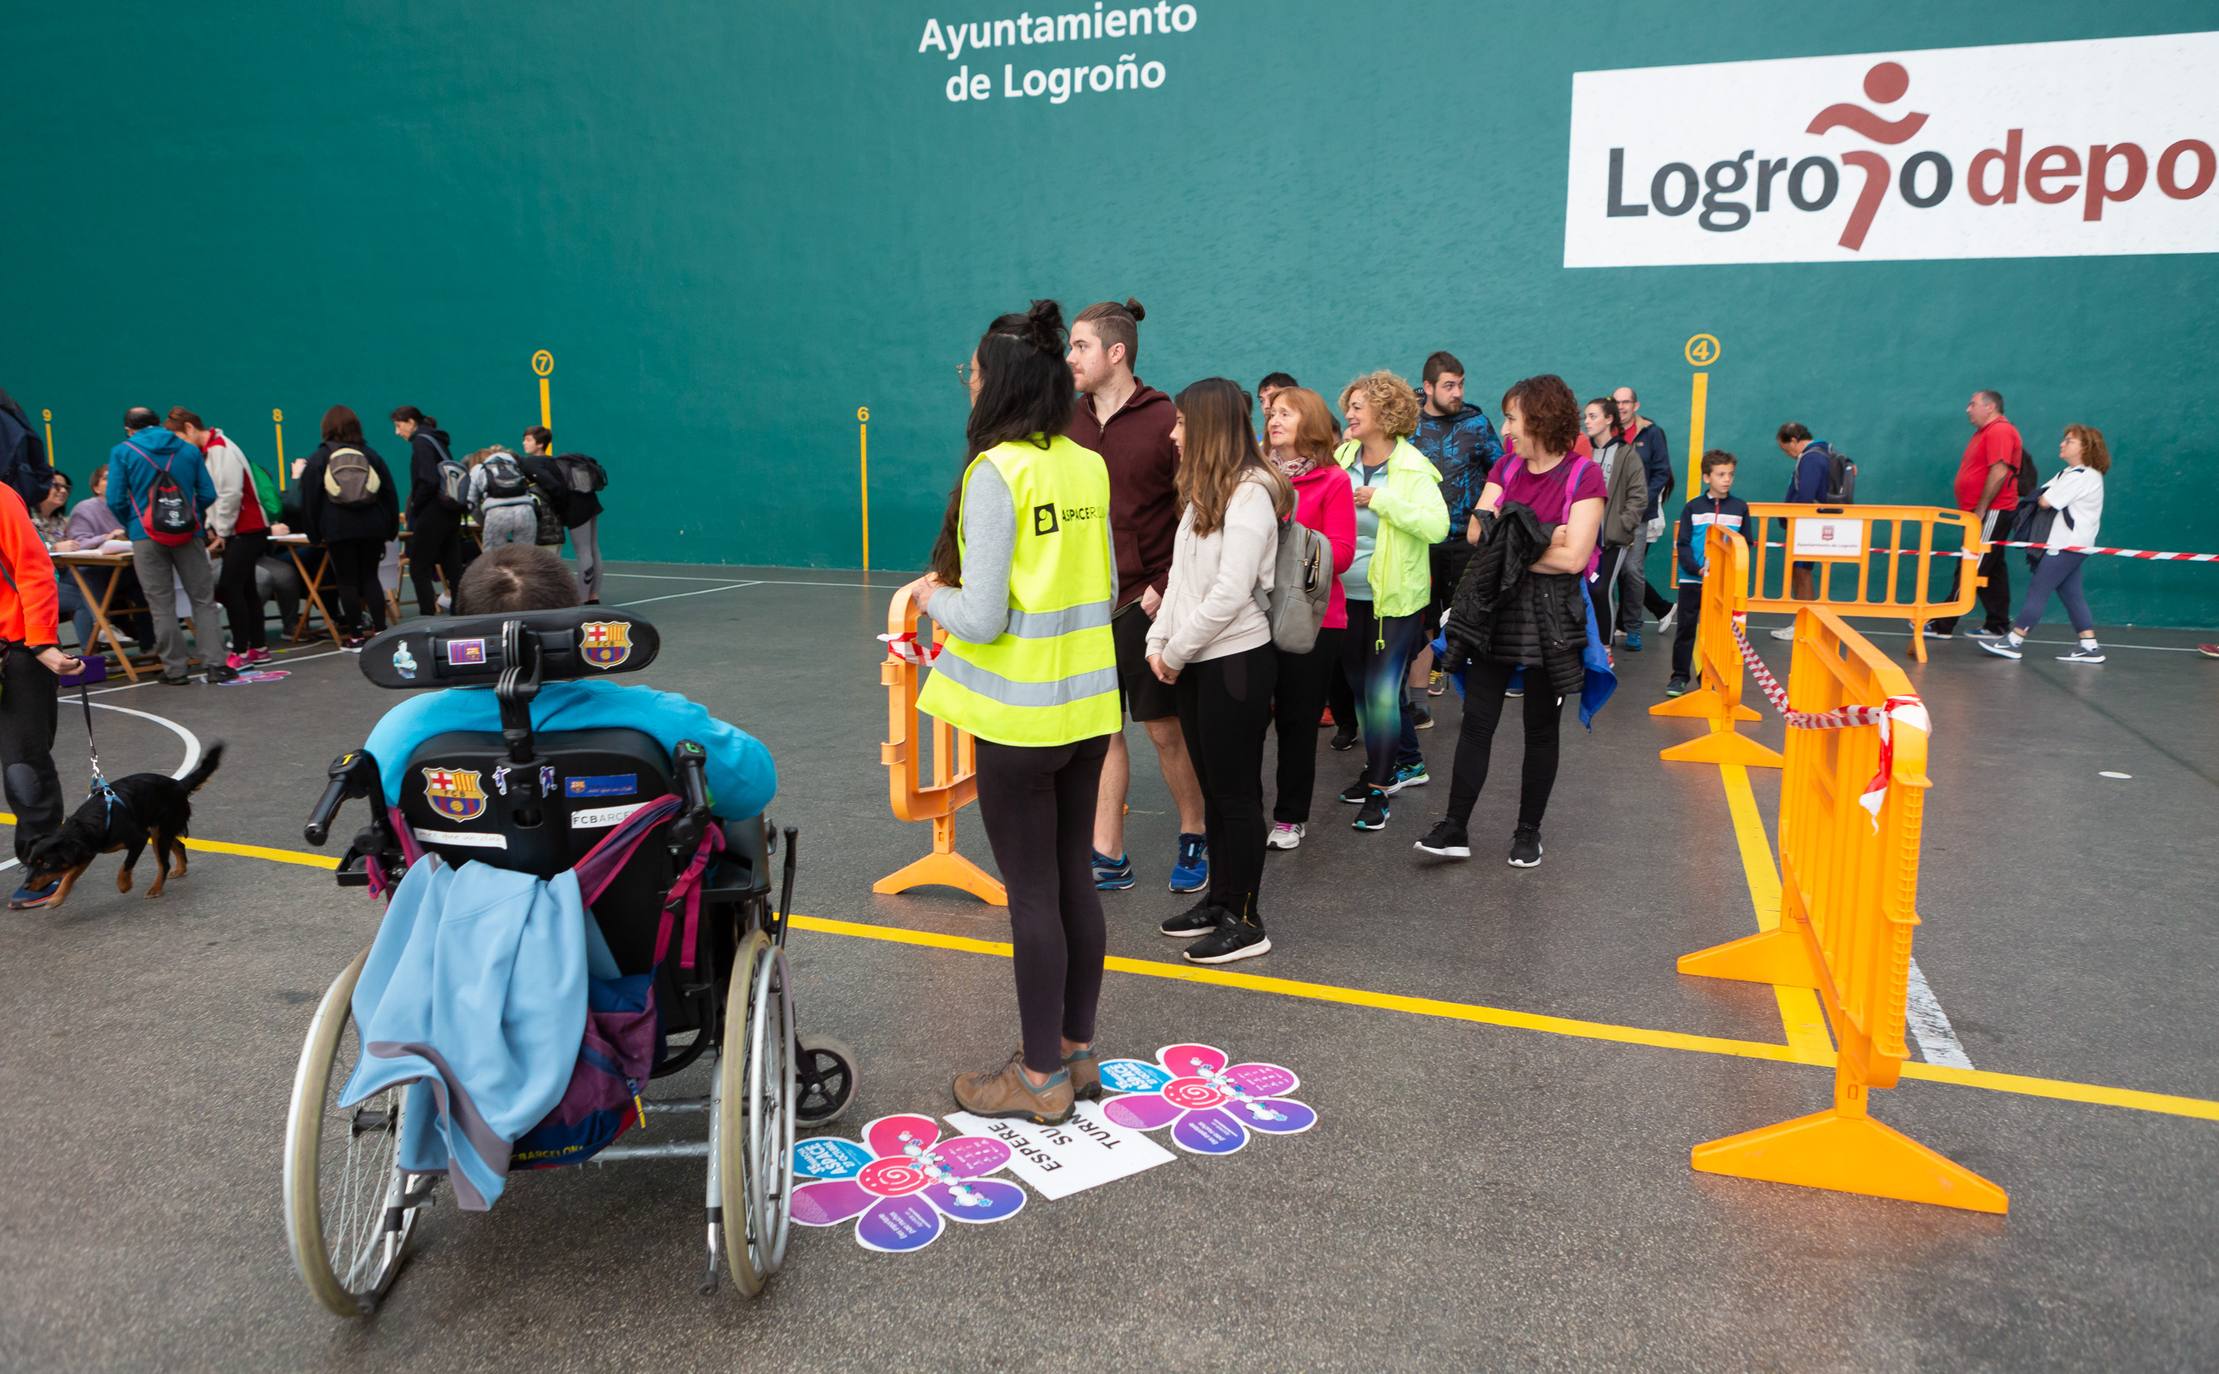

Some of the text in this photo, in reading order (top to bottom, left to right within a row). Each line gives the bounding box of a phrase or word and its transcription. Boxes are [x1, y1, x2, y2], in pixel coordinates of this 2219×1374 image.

[918, 0, 1197, 60] Ayuntamiento
[946, 53, 1167, 104] de Logroño
[1967, 128, 2218, 222] depo
[1692, 340, 1710, 361] 4
[42, 408, 52, 422] 9
[857, 406, 870, 422] 6
[988, 1122, 1063, 1171] ESPERE
[1039, 1128, 1073, 1146] SU
